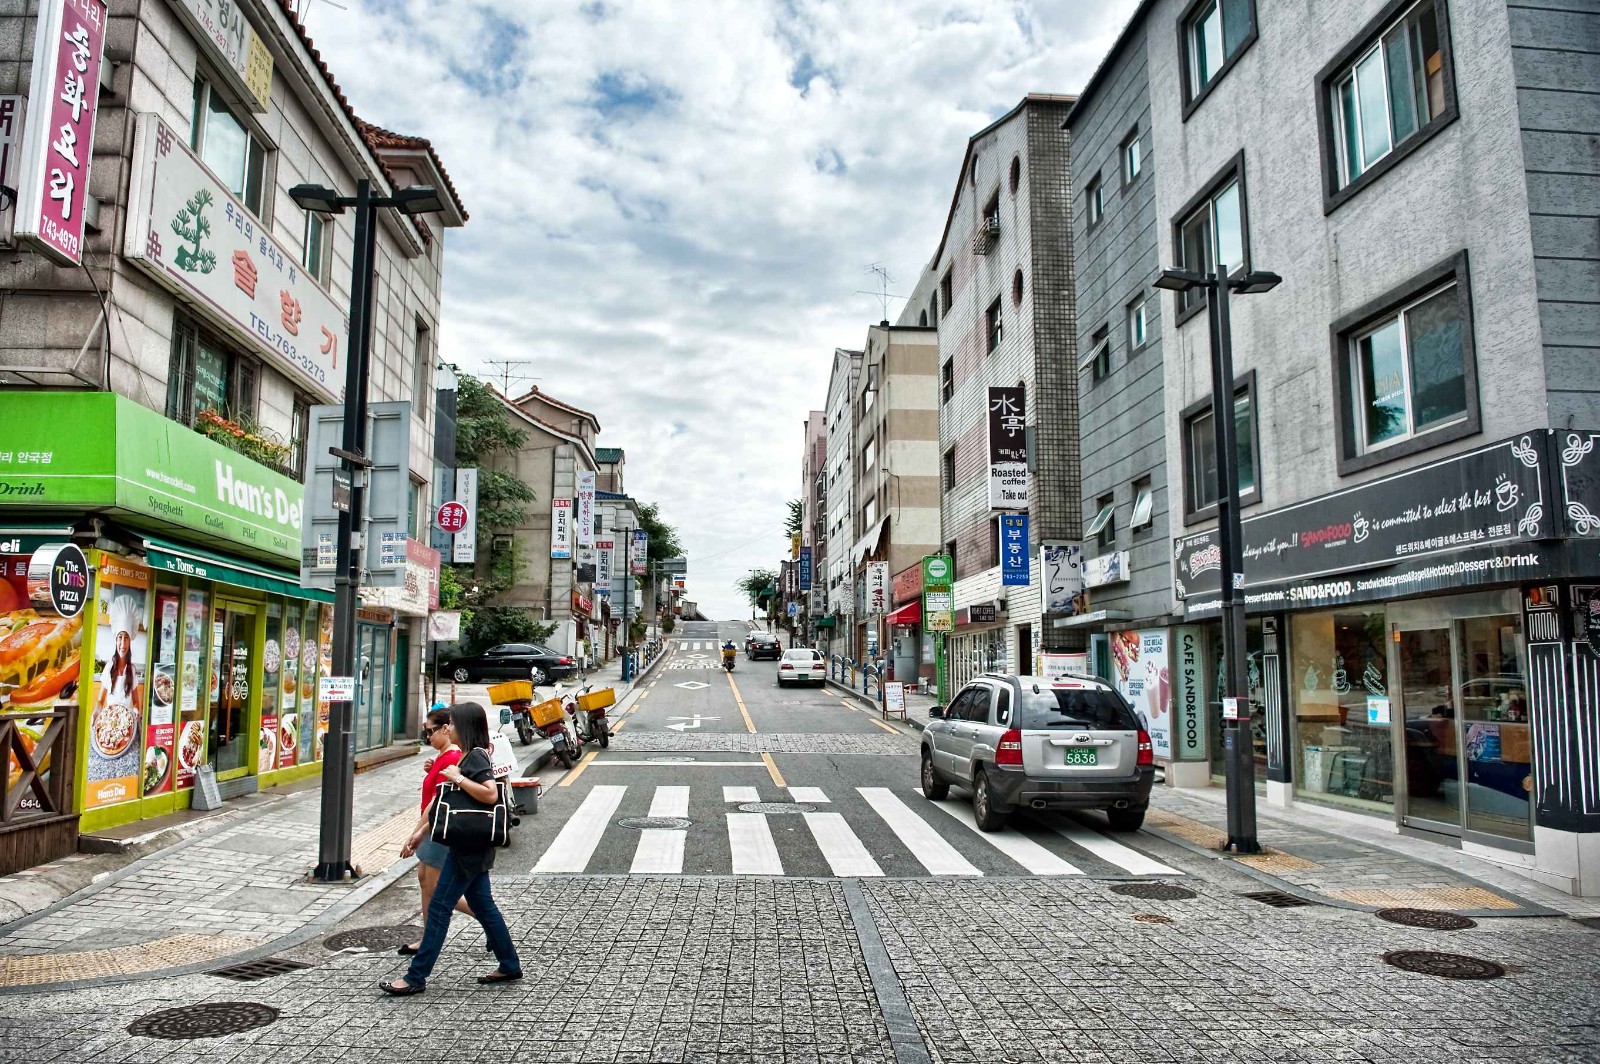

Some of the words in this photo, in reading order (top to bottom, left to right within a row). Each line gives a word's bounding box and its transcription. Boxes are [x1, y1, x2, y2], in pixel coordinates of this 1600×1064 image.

[203, 0, 245, 49] 영사
[42, 214, 79, 255] 743-4979
[225, 201, 254, 244] 우리의
[259, 235, 284, 273] 음식과
[288, 265, 296, 285] 차
[249, 311, 326, 383] TEL:763-3273
[0, 451, 13, 464] 리
[18, 451, 53, 465] 안국점
[991, 467, 1027, 478] Roasted
[0, 481, 46, 496] Drink
[1002, 477, 1026, 486] coffee
[215, 459, 275, 520] Han's
[275, 496, 304, 530] Del
[1001, 489, 1017, 500] Take
[1017, 490, 1028, 500] out
[148, 495, 184, 518] Spaghetti
[1381, 505, 1422, 530] committed
[1422, 505, 1433, 521] to
[1433, 497, 1458, 517] select
[1458, 492, 1473, 512] the
[1474, 489, 1492, 509] best
[1487, 523, 1512, 537] 전문점
[1007, 529, 1023, 568] 부동산
[1262, 537, 1276, 554] with
[65, 560, 78, 573] The
[109, 565, 119, 576] THE
[119, 567, 135, 579] TOM'S
[135, 569, 148, 580] PIZZA
[166, 560, 176, 570] The
[56, 565, 86, 588] Tom's
[59, 590, 79, 602] PIZZA
[1183, 634, 1195, 665] CAFE
[1184, 668, 1198, 749] SAND&FOOD
[1066, 753, 1096, 764] 5838
